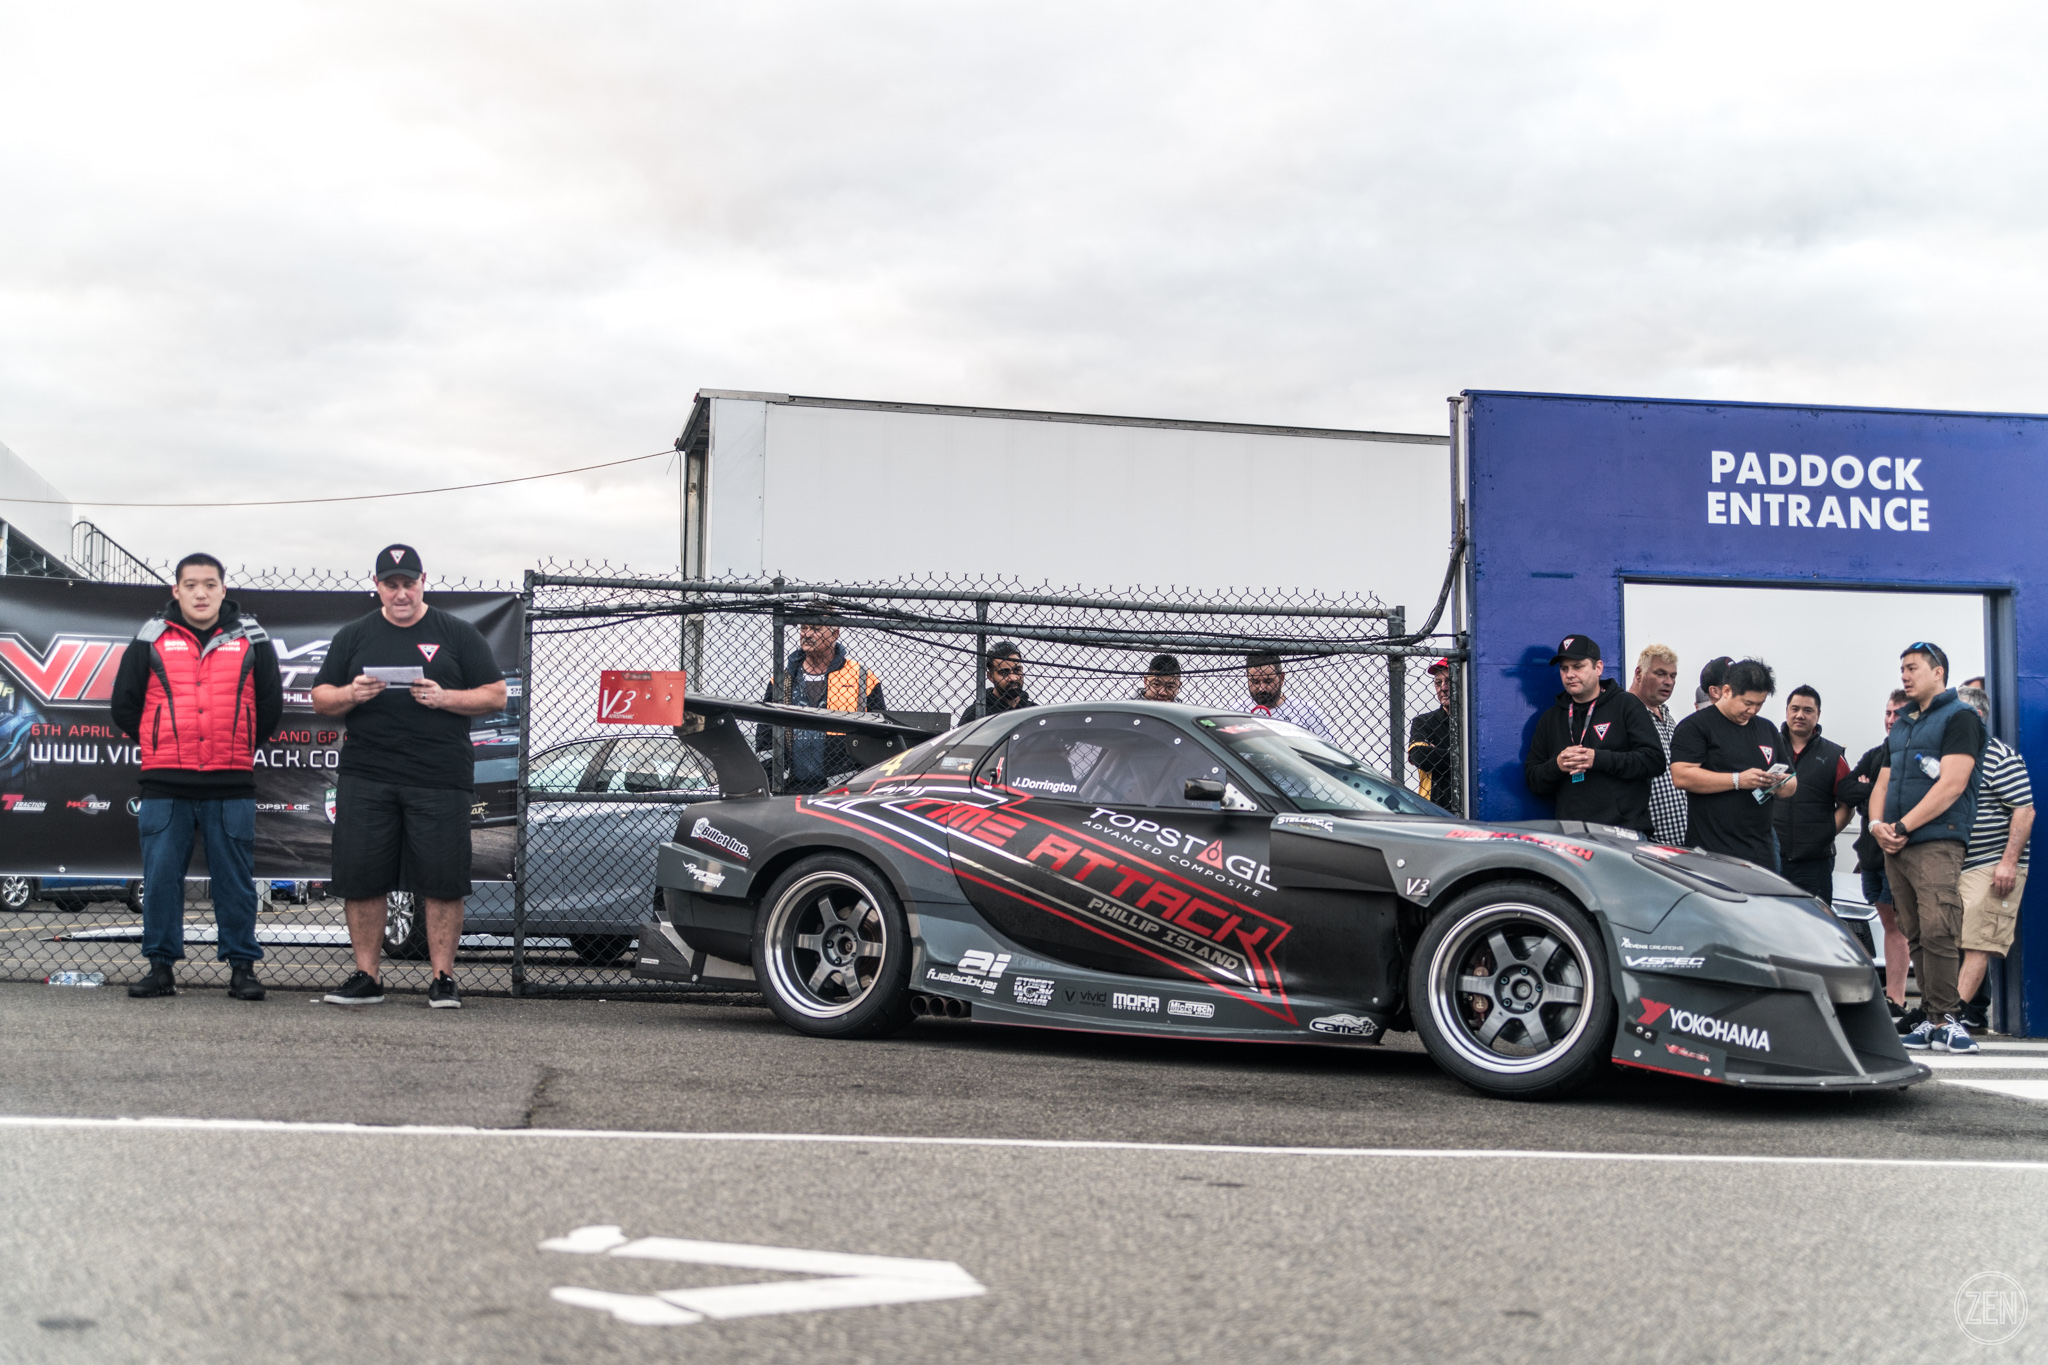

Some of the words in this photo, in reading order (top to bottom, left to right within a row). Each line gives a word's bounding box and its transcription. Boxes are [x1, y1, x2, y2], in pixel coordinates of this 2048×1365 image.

[1711, 450, 1924, 491] PADDOCK
[1706, 491, 1930, 532] ENTRANCE
[601, 690, 637, 719] V3
[31, 724, 62, 737] 6TH
[69, 726, 114, 738] APRIL
[317, 731, 338, 743] GP
[1011, 777, 1078, 794] J.Dorrington
[14, 801, 48, 809] TRACTION
[701, 826, 730, 849] Billet
[727, 838, 749, 858] Inc.
[1082, 820, 1162, 856] ADVANCED
[1169, 855, 1262, 898] COMPOSITE
[1406, 877, 1430, 896] V3
[903, 798, 1027, 847] TIME
[1026, 833, 1272, 999] ATTACK
[1088, 897, 1160, 933] PHILLIP
[1162, 930, 1239, 970] ISLAND
[1649, 944, 1685, 952] CREATIONS
[926, 968, 998, 990] fueledbyai
[1079, 990, 1107, 1003] vivid
[1112, 1005, 1160, 1013] MOTORSPORT
[1169, 1001, 1212, 1015] MicroTech
[1669, 1007, 1771, 1053] YOKOHAMA
